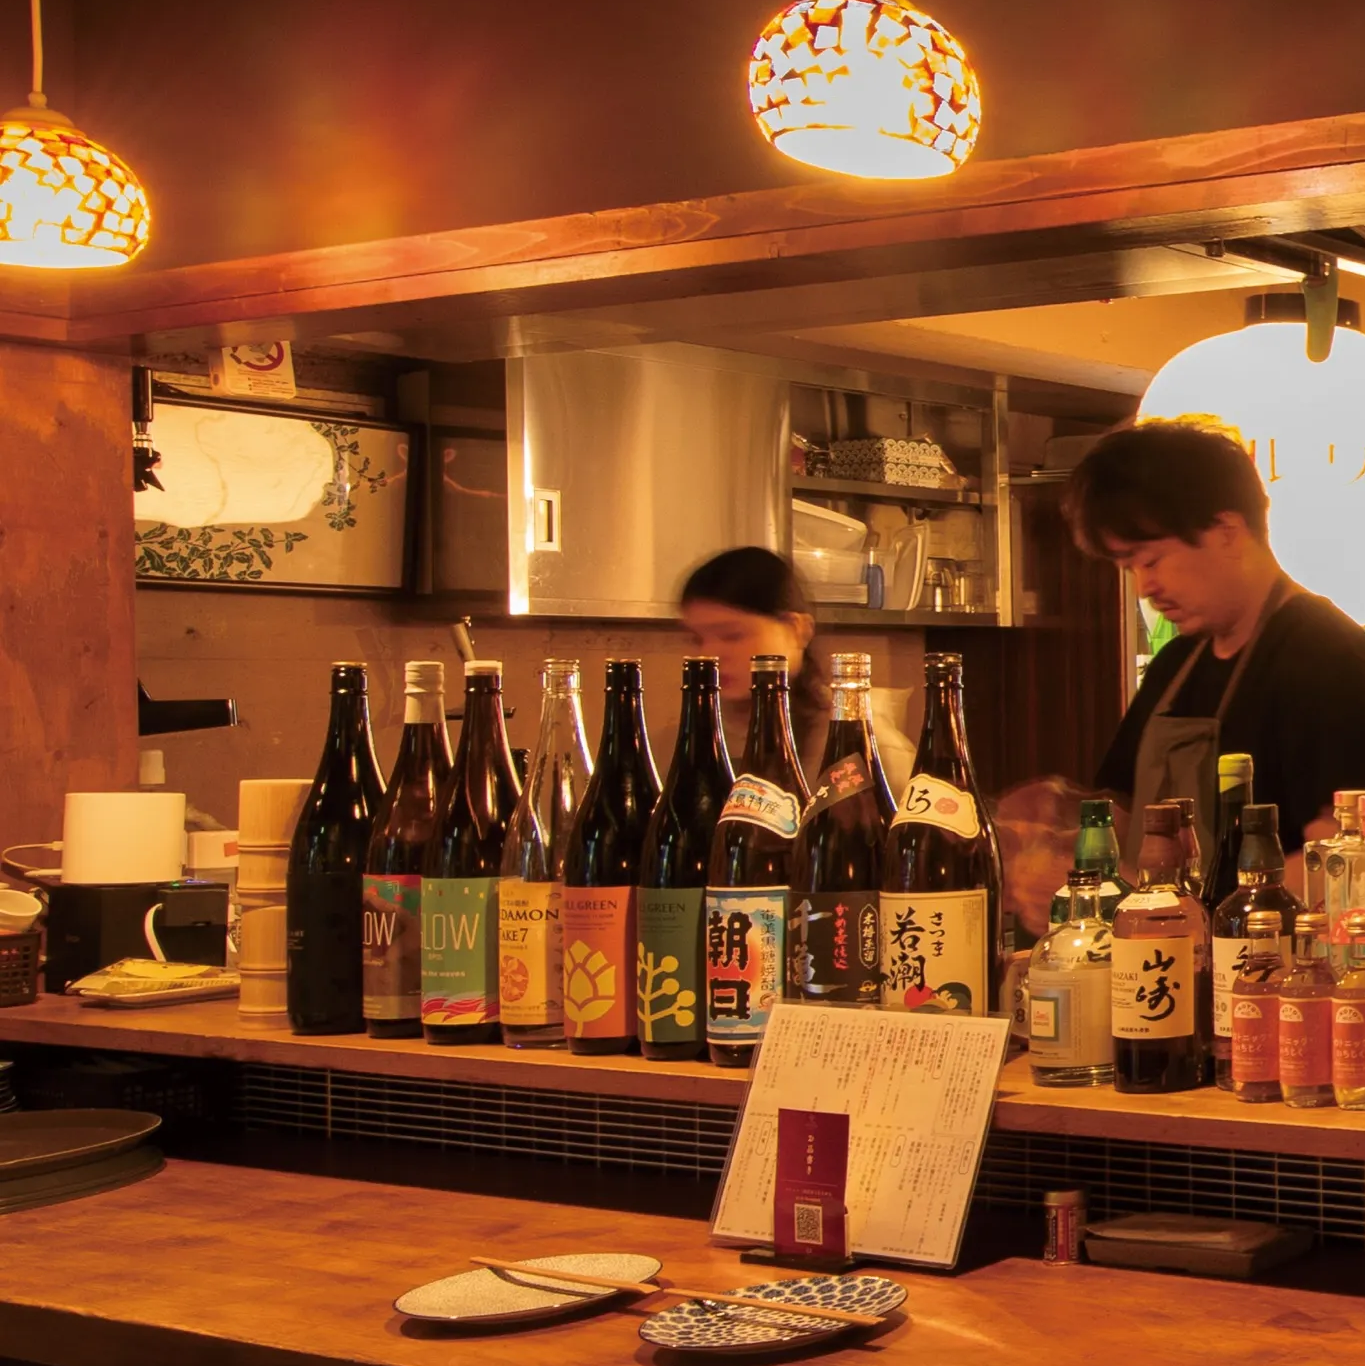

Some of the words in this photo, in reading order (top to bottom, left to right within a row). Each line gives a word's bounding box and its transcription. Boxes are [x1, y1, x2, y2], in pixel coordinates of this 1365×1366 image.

[362, 911, 396, 946] OW
[519, 927, 529, 943] 7
[761, 909, 776, 991] 奄美黒糖焼酎
[889, 906, 926, 993] 若潮
[928, 911, 945, 957] さつま
[709, 910, 752, 1022] 朝日
[1135, 948, 1181, 1022] 山崎
